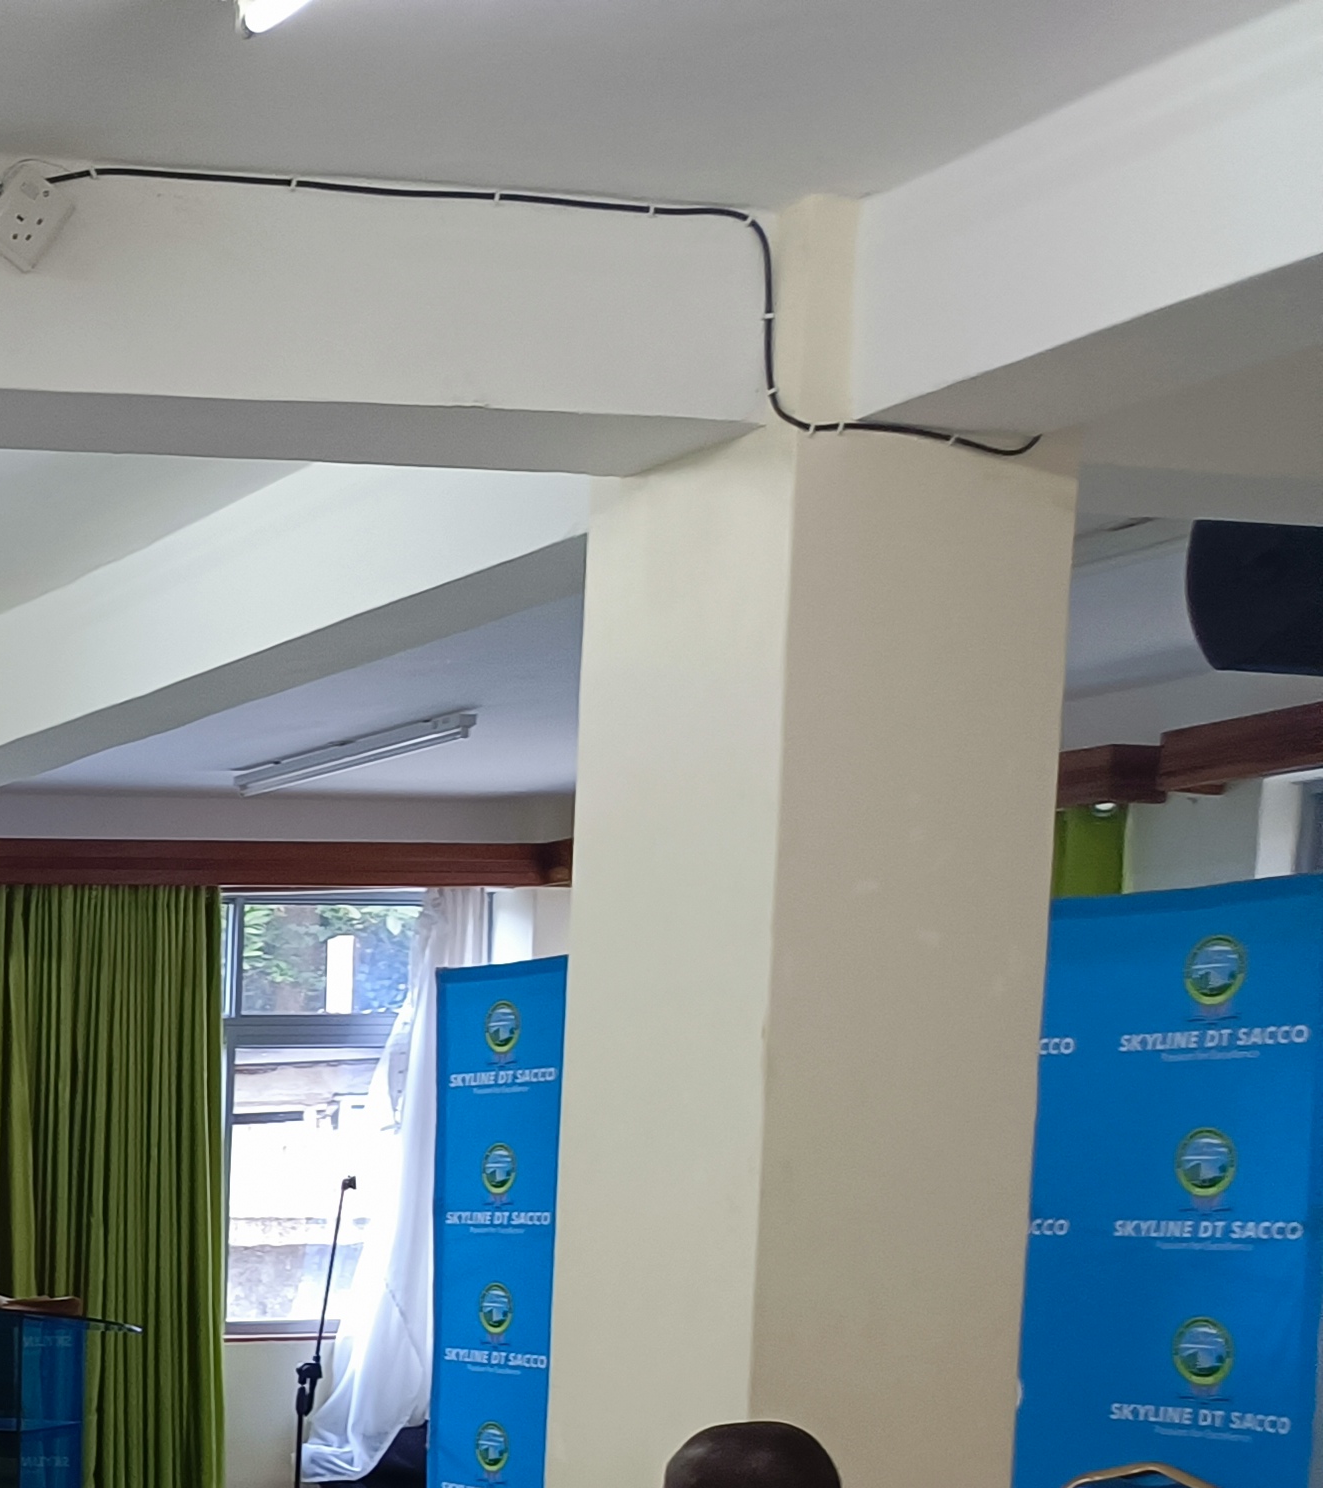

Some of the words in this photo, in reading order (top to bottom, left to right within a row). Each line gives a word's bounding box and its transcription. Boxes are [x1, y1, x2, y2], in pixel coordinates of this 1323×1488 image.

[1039, 1037, 1075, 1055] CCO
[1118, 1031, 1200, 1052] SKYLINE
[1204, 1029, 1230, 1048] DT
[1236, 1025, 1310, 1047] SACCO
[449, 1071, 495, 1087] SKYLINE
[497, 1071, 513, 1084] DT
[515, 1067, 558, 1083] SACCO
[445, 1211, 492, 1225] SKYLINE
[493, 1211, 510, 1225] DT
[510, 1211, 551, 1225] SACCO
[1029, 1219, 1070, 1236] CCO
[1113, 1220, 1193, 1237] SKYLINE
[1198, 1221, 1224, 1238] DT
[1229, 1221, 1304, 1240] SACCO
[444, 1348, 489, 1364] SKYLINE
[490, 1351, 507, 1365] DT
[507, 1353, 547, 1368] SACCO
[1109, 1402, 1194, 1425] SKYLINE
[1198, 1409, 1225, 1427] DT
[1229, 1412, 1291, 1435] SACCO
